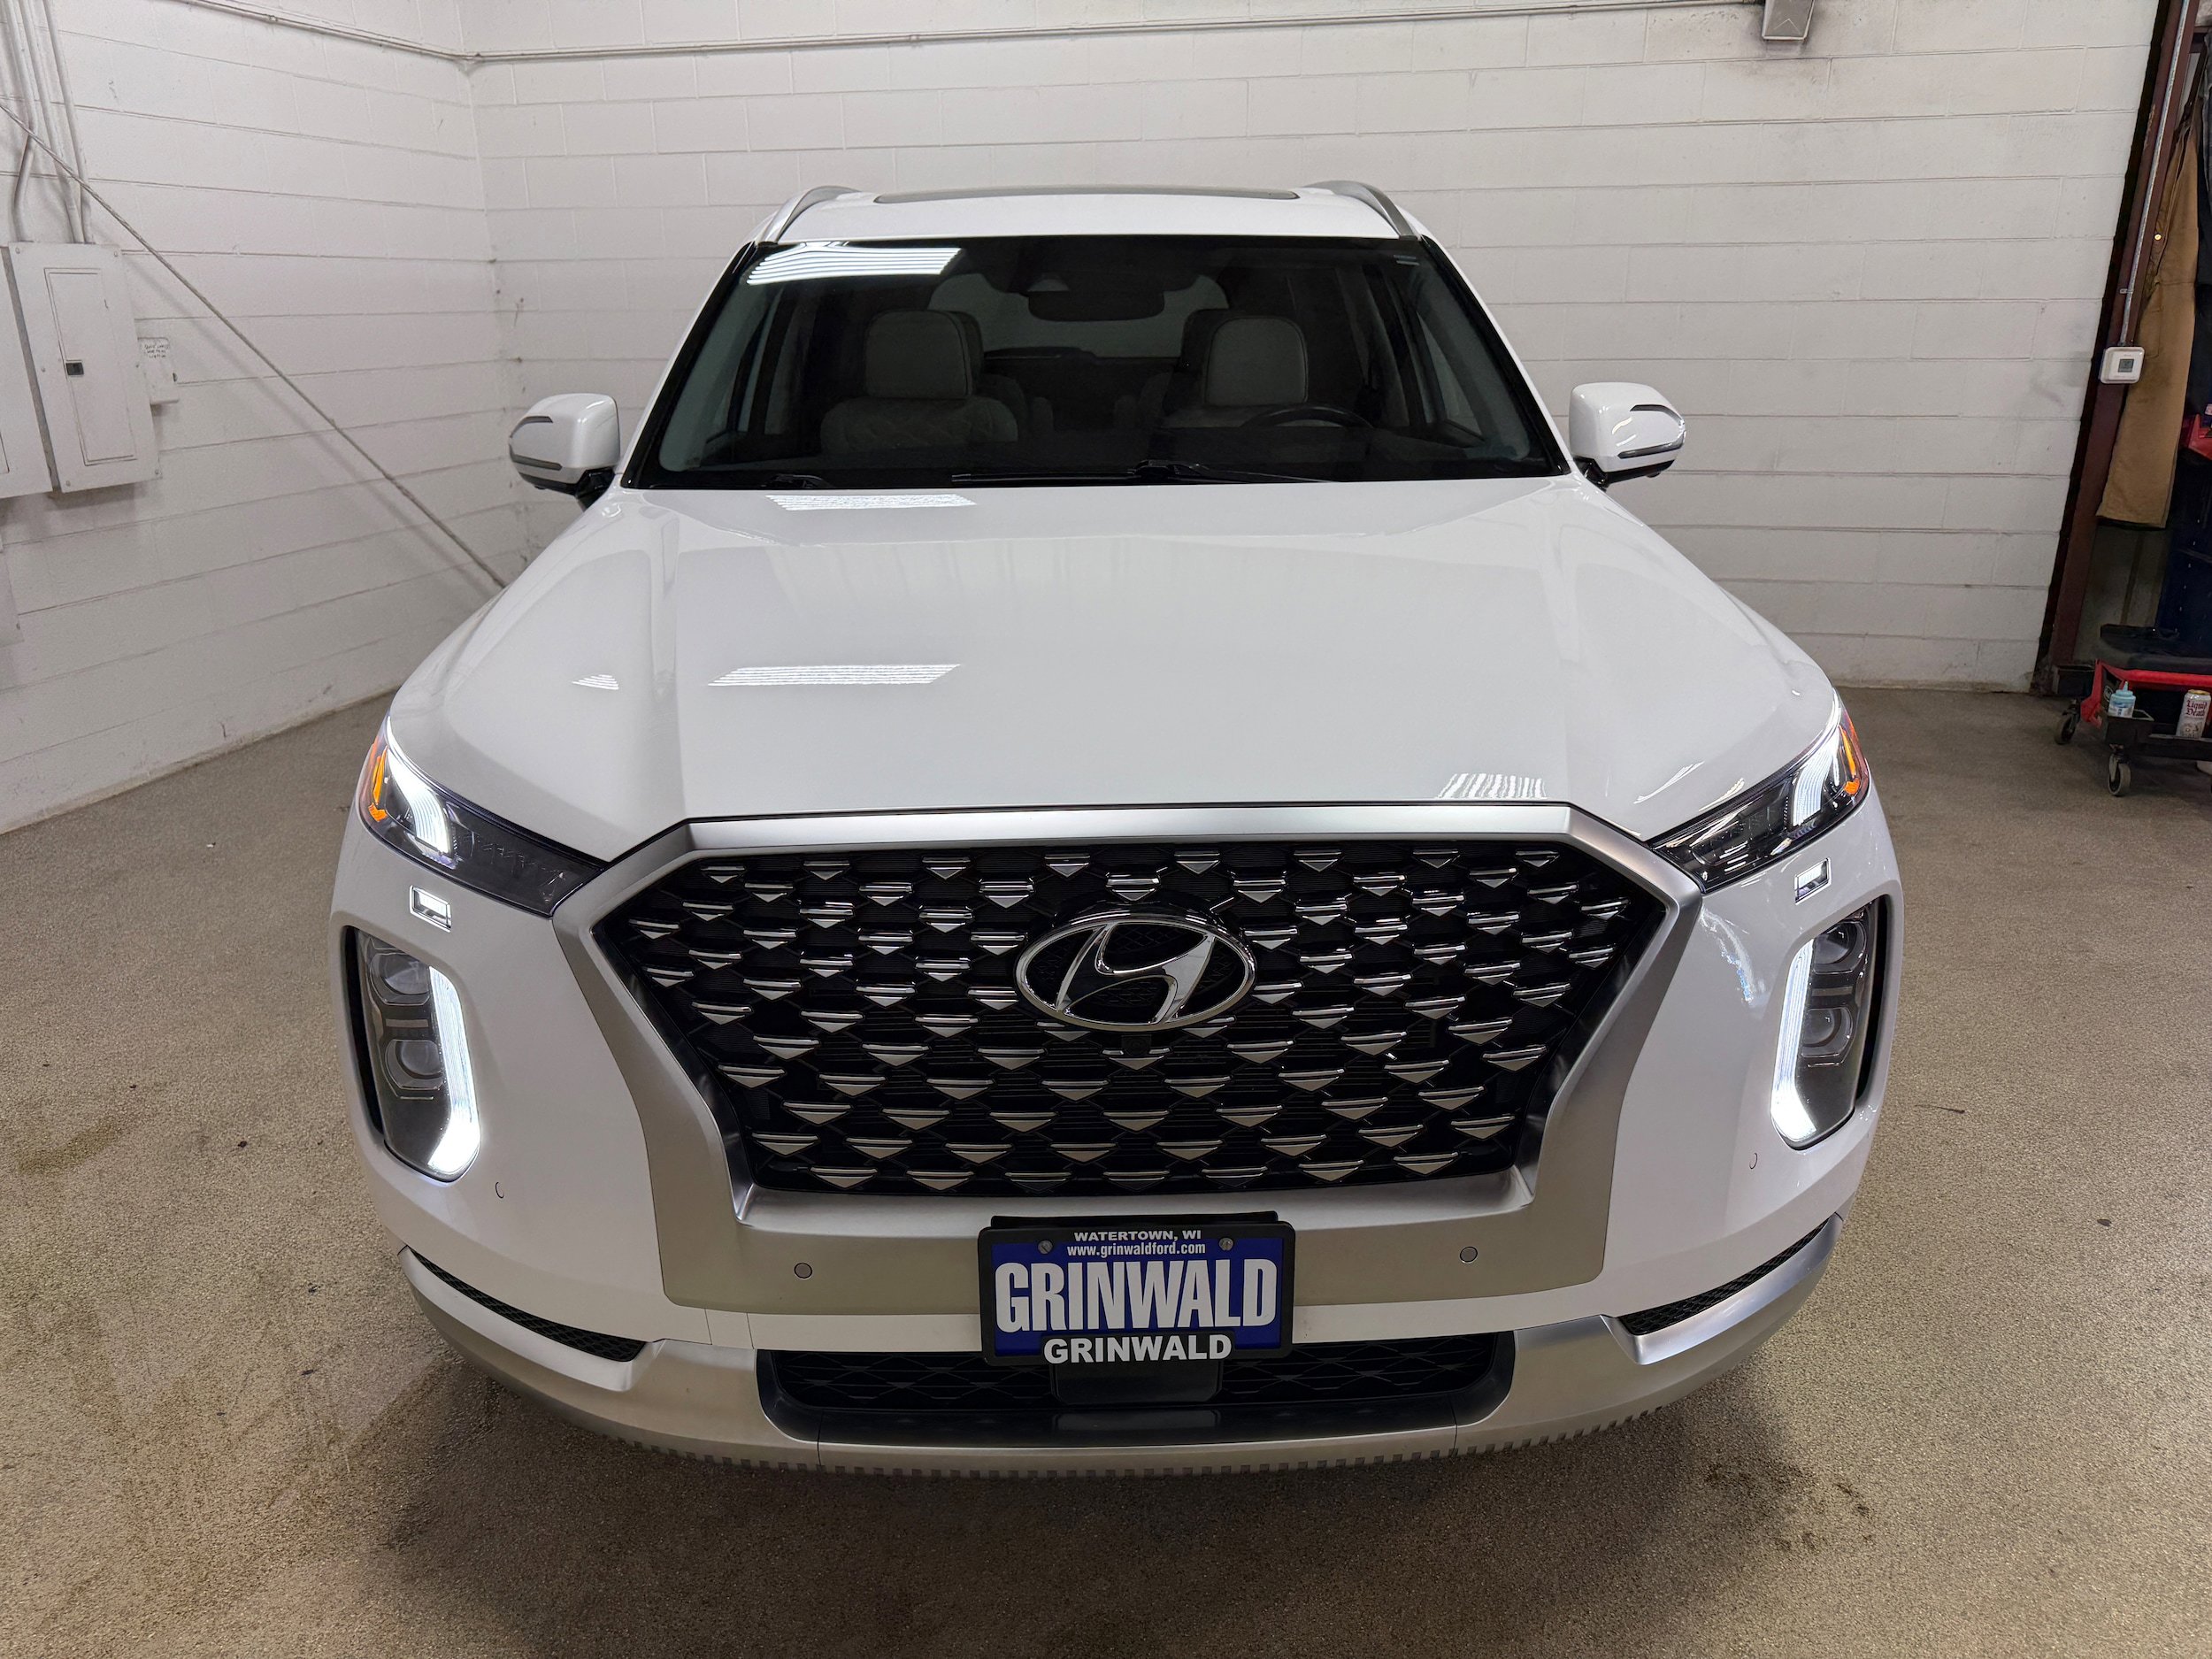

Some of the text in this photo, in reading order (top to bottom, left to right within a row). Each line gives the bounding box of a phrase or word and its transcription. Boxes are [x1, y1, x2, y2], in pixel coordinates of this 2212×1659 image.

[1073, 1230, 1202, 1242] WATERTOWN, WI
[1067, 1242, 1206, 1258] www.grinwaldford.com
[995, 1258, 1278, 1333] GRINWALD
[1043, 1334, 1233, 1363] GRINWALD
